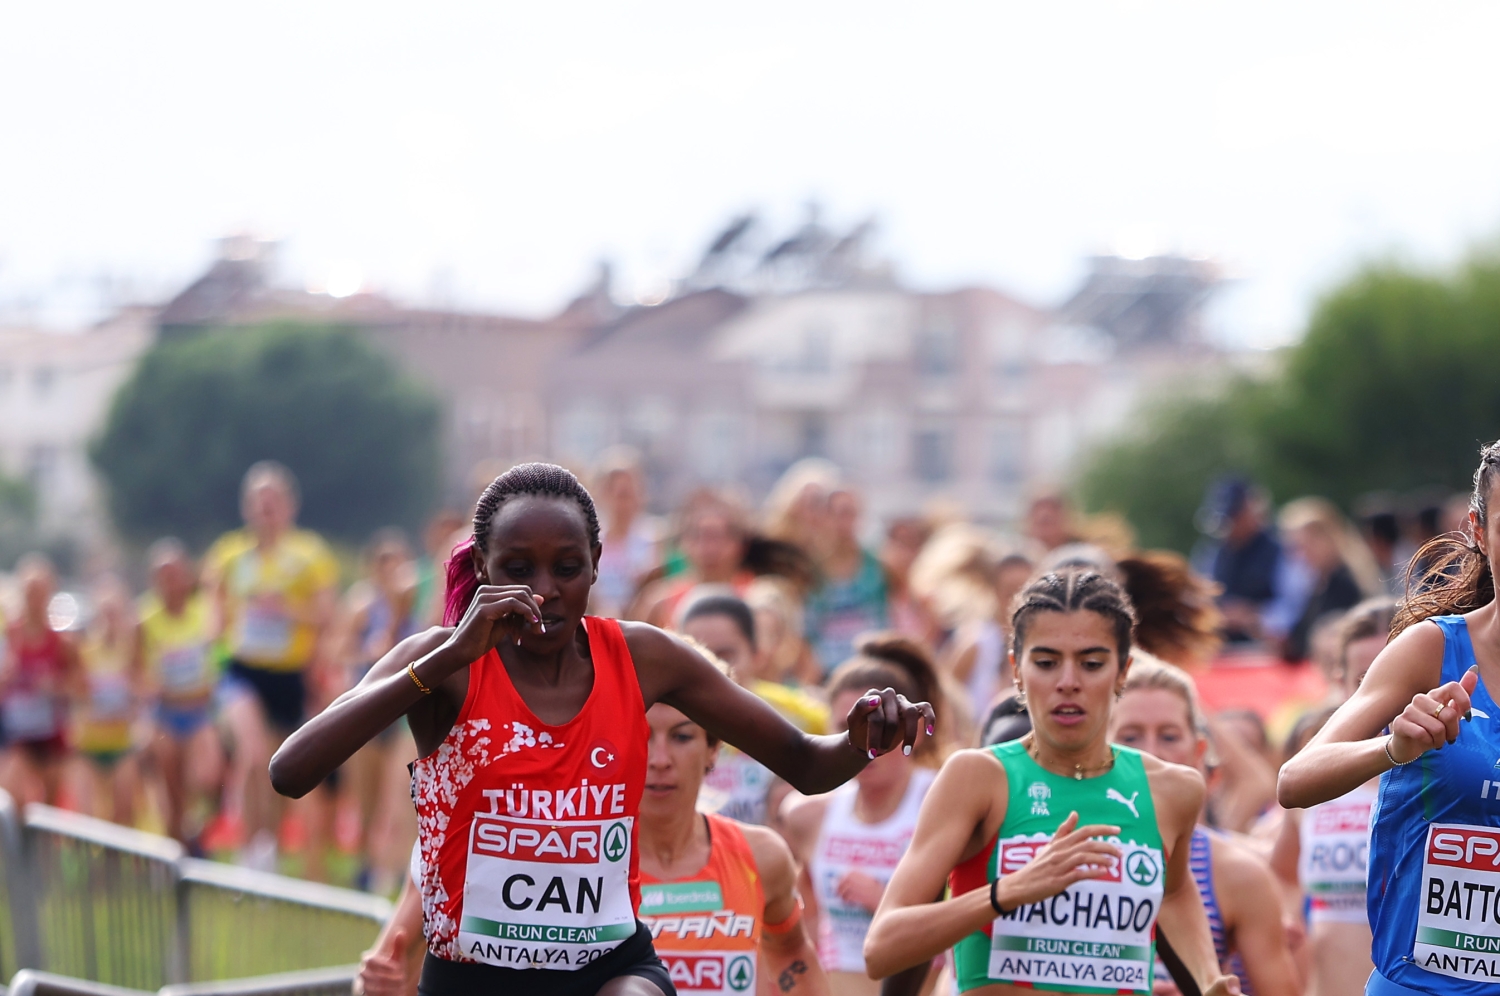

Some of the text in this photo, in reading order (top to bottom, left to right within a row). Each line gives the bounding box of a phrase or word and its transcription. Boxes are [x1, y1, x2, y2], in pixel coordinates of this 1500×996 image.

[476, 822, 598, 859] SPAR
[501, 873, 604, 915] CAN
[498, 924, 503, 937] I
[506, 924, 543, 940] RUN
[1455, 933, 1461, 947] I
[1463, 934, 1500, 952] RUN
[469, 940, 570, 965] ANTALYA
[1026, 938, 1032, 951] I
[1034, 939, 1070, 955] RUN
[1000, 957, 1146, 984] ANTALYA 2024
